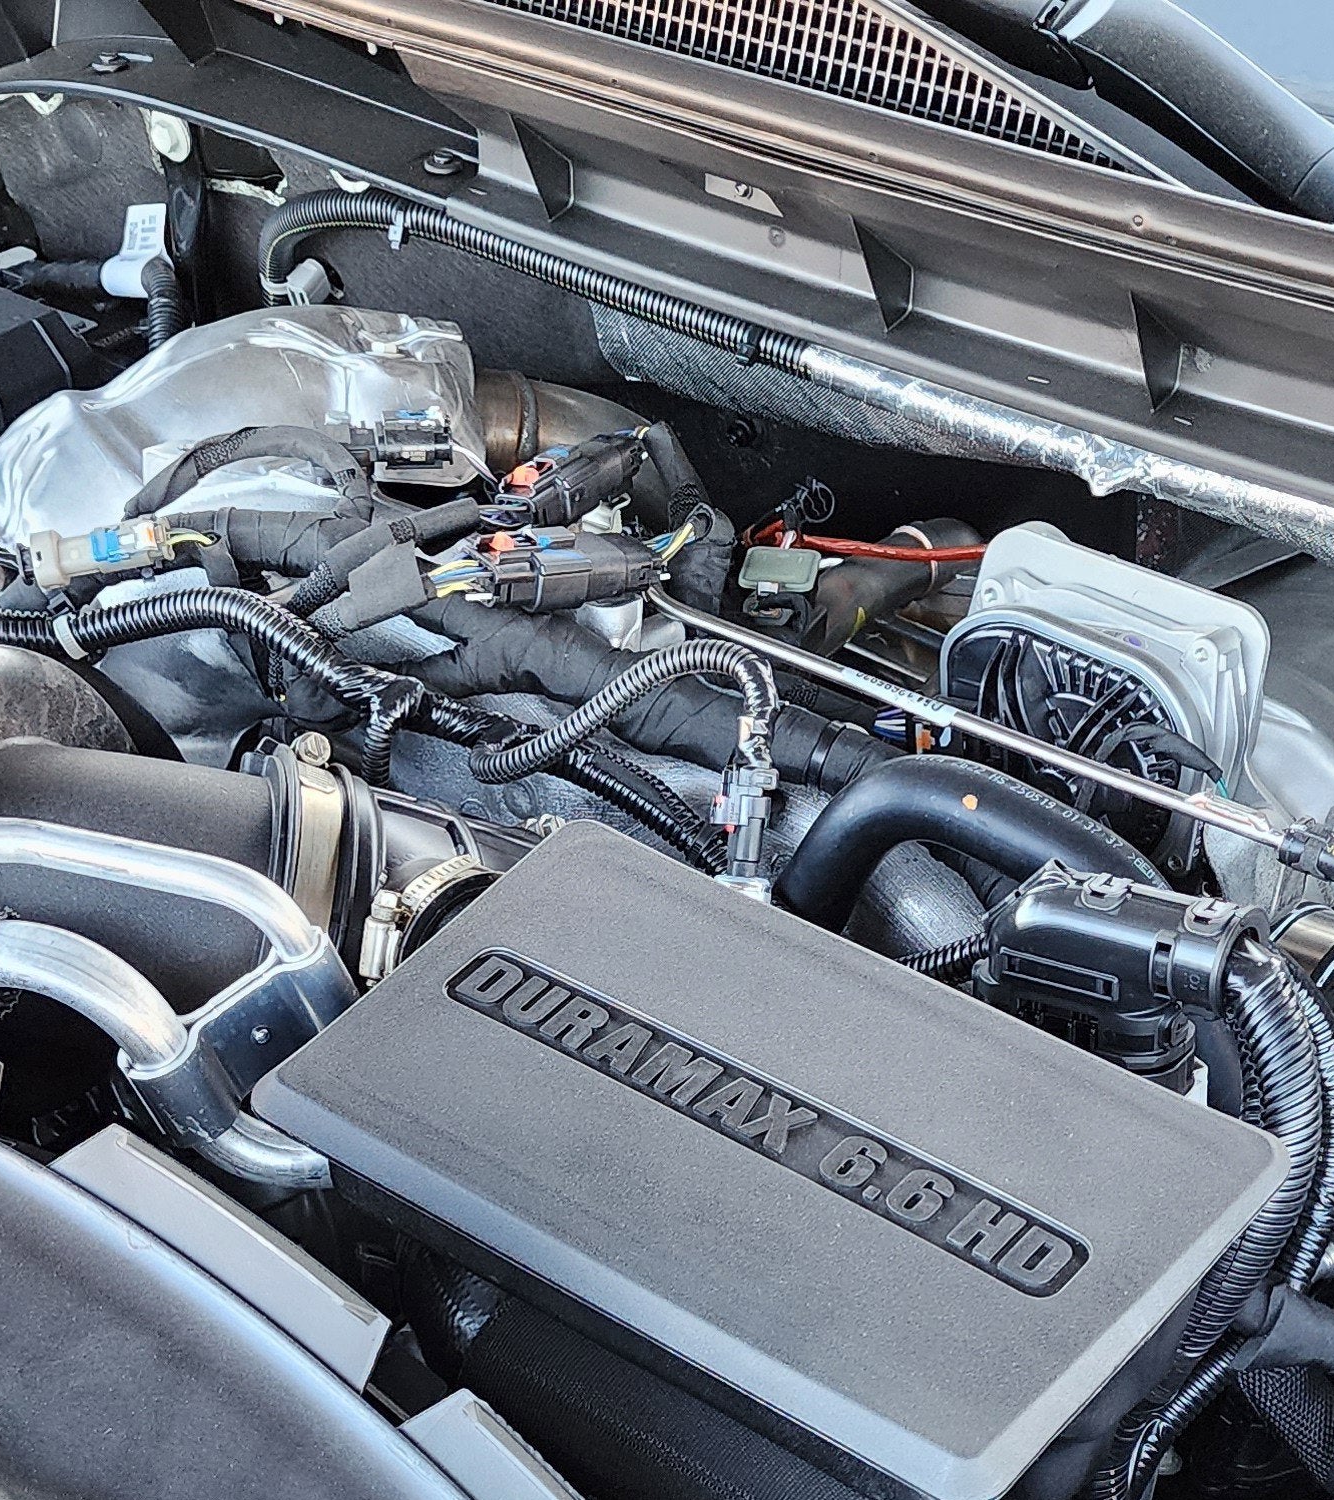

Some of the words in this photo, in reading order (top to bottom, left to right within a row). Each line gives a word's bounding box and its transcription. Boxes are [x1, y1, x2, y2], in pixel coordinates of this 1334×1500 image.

[458, 954, 820, 1155] DURAMAX
[818, 1135, 955, 1224] 6.6
[946, 1203, 1078, 1288] HD
